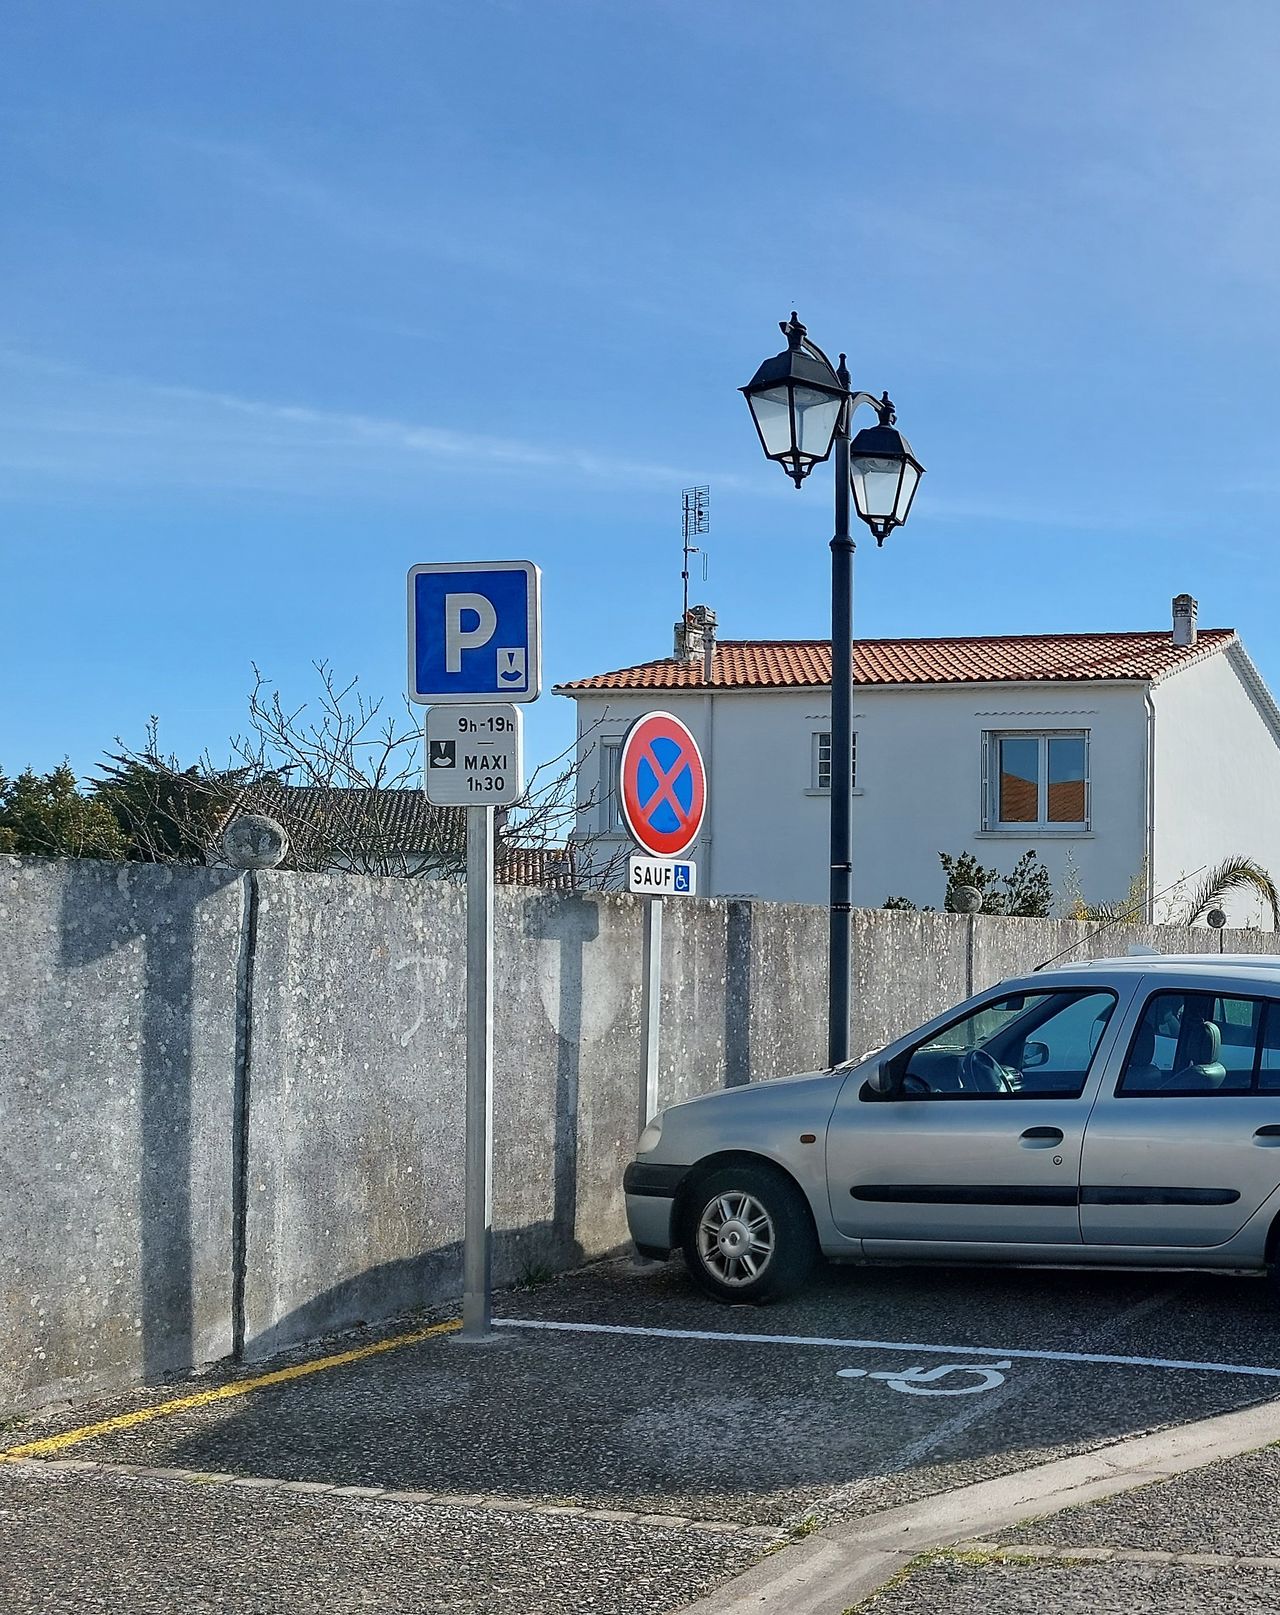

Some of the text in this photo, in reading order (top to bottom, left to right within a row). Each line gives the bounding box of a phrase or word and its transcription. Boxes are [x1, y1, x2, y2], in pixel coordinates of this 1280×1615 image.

[445, 593, 497, 673] P
[464, 755, 507, 770] MAXI
[466, 776, 505, 791] 1h30
[633, 865, 671, 886] SAUF
